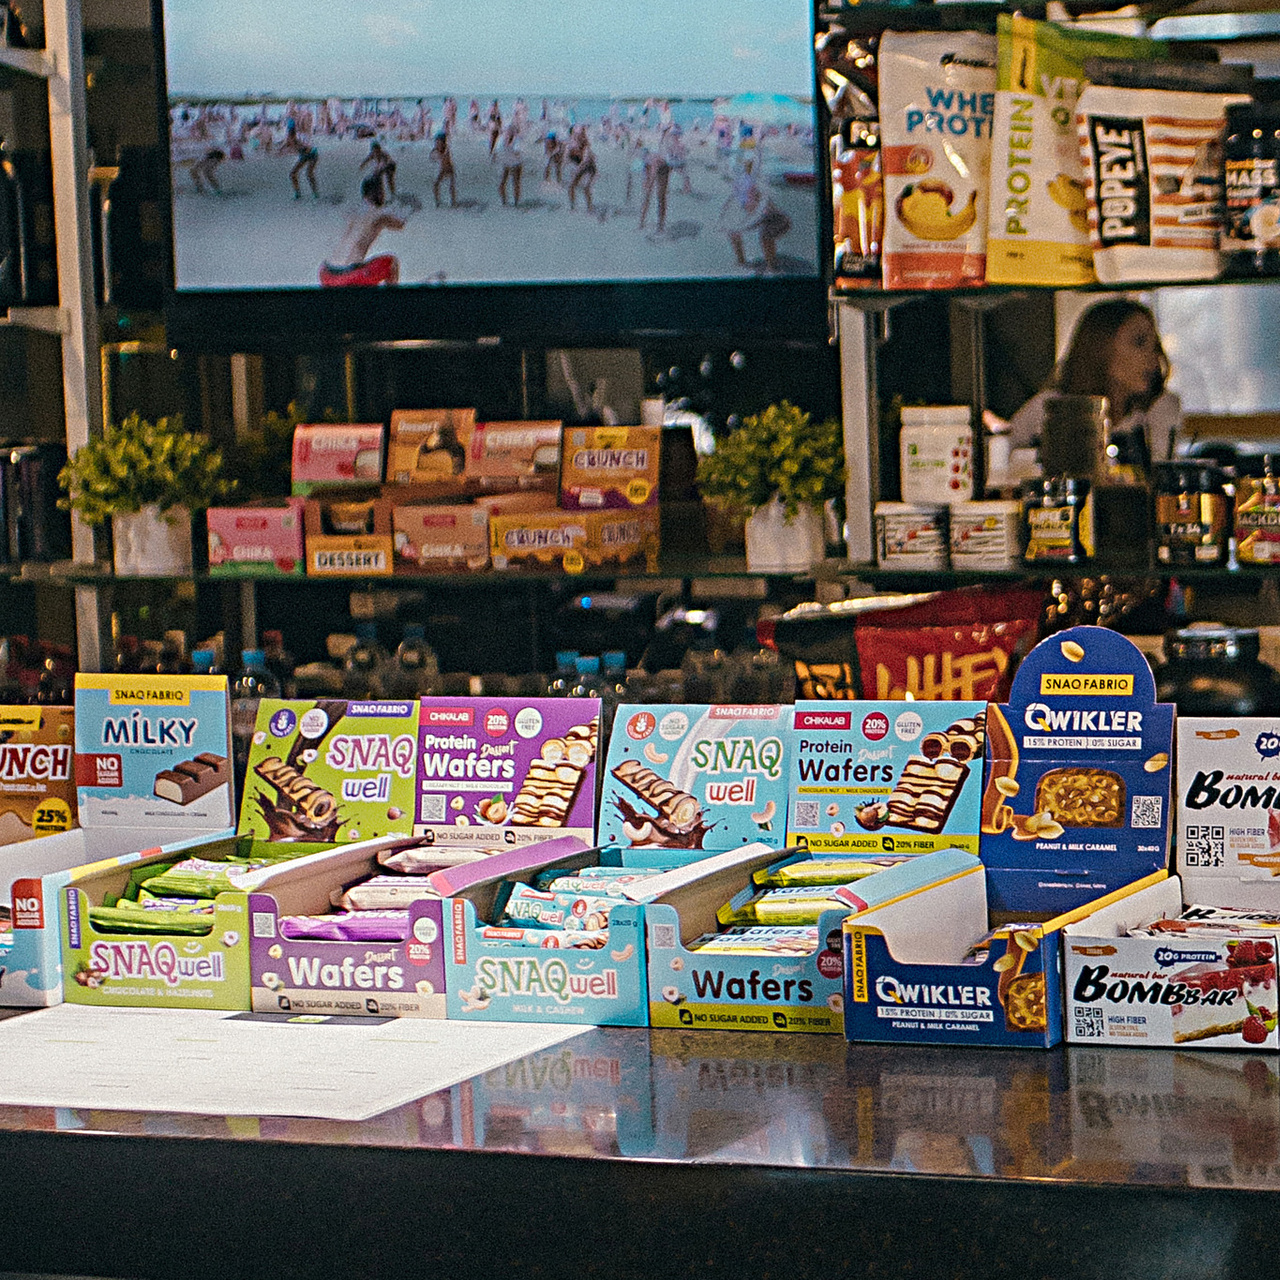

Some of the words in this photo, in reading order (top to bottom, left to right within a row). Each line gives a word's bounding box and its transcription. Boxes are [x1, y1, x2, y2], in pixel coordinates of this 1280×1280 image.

[926, 87, 995, 115] WHE
[906, 109, 993, 138] PROT
[1005, 99, 1034, 234] PROTEIN
[1096, 122, 1137, 238] POPEYE
[573, 449, 648, 470] CRUNCH
[505, 529, 573, 548] CRUNCH
[316, 551, 384, 568] DESSERT
[429, 712, 470, 722] CHIKALAB
[486, 715, 508, 725] 20%
[803, 716, 846, 726] CHIKALAB
[864, 719, 886, 729] 20%
[424, 734, 477, 749] Protein
[799, 739, 853, 753] Protein
[1028, 738, 1046, 747] 15%
[1047, 738, 1083, 748] PROTEIN
[1091, 739, 1105, 748] 0%
[1107, 739, 1137, 748] SUGAR
[328, 735, 416, 776] SNAQ
[690, 738, 783, 778] SNAQ
[96, 757, 118, 770] NO
[423, 752, 515, 778] Wafers
[798, 758, 893, 783] Wafers
[344, 776, 388, 799] well
[709, 778, 756, 802] well
[36, 809, 67, 823] 25%
[436, 832, 449, 840] NO
[450, 833, 475, 841] SUGAR
[476, 833, 501, 841] ADDED
[810, 839, 823, 847] NO
[823, 839, 850, 847] SUGAR
[850, 840, 878, 848] ADDED
[895, 840, 912, 848] 20%
[913, 841, 935, 849] FIBER
[1036, 842, 1061, 850] PEANUT
[1085, 843, 1118, 852] CARAMEL
[15, 897, 39, 911] NO
[408, 943, 431, 954] 20%
[820, 956, 842, 967] 20%
[1180, 953, 1216, 962] PROTEIN
[287, 956, 404, 989] Wafers
[692, 969, 814, 1002] Wafers
[305, 1000, 334, 1009] SUGAR
[334, 1001, 362, 1009] ADDED
[694, 1013, 708, 1022] NO
[709, 1014, 738, 1023] SUGAR
[739, 1016, 769, 1024] ADDED
[880, 1008, 898, 1016] 15%
[899, 1009, 936, 1018] PROTEIN
[960, 1011, 991, 1020] SUGAR
[892, 1021, 919, 1029] PEANUT
[945, 1023, 980, 1031] CARAMEL
